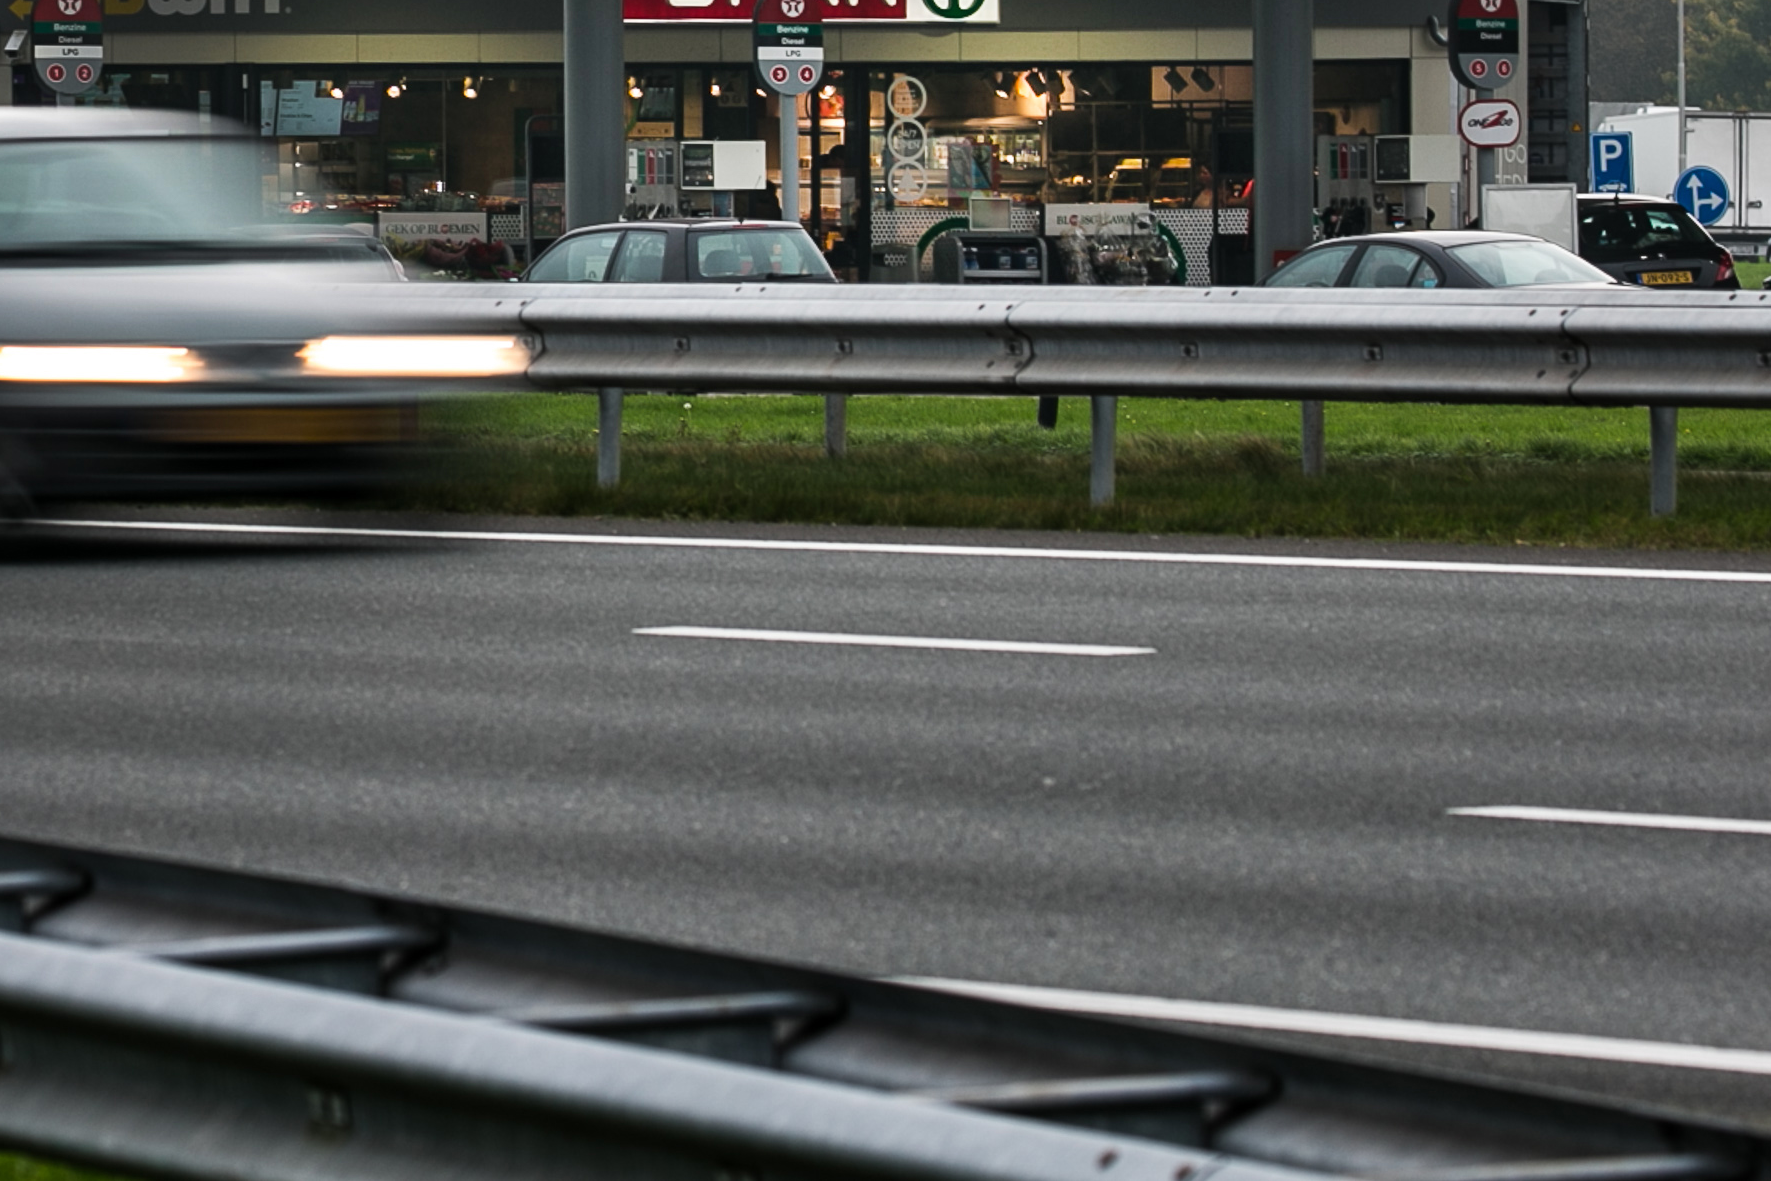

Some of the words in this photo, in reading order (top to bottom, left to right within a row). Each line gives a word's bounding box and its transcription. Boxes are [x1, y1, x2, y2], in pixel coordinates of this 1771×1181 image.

[53, 23, 87, 32] Benzine
[1475, 19, 1506, 28] Benzine
[776, 25, 809, 34] Benzine
[58, 35, 83, 44] Diesel
[1480, 32, 1502, 40] Diesel
[781, 37, 805, 45] Diesel
[62, 48, 79, 56] LPG
[1599, 139, 1623, 172] P
[386, 223, 408, 235] GEK
[410, 224, 426, 234] OP
